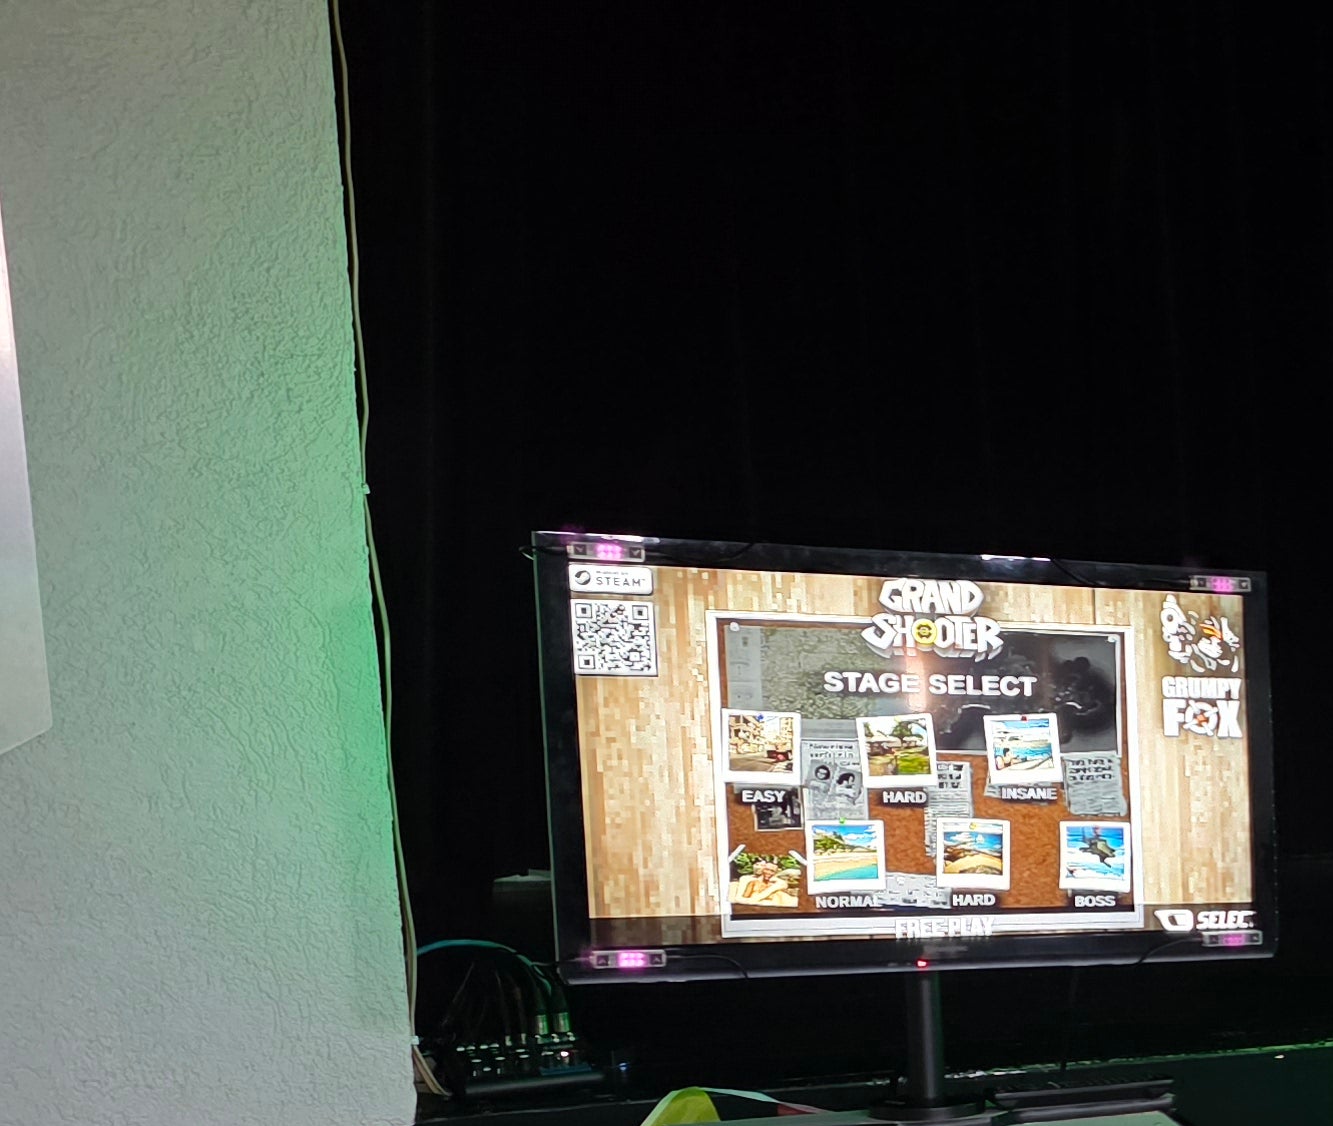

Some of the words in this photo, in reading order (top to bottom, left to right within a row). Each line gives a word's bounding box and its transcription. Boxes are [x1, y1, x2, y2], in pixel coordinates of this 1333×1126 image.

[878, 578, 985, 616] GRAND
[861, 612, 1004, 657] SHOOTER
[823, 671, 920, 695] STAGE
[928, 674, 1038, 698] SELECT
[1161, 676, 1242, 700] GRUMPY
[741, 789, 786, 803] EASY
[882, 790, 927, 804] HARD
[1001, 787, 1058, 801] INSANE
[815, 895, 882, 909] NORMAL
[952, 893, 996, 907] HARD
[1074, 895, 1116, 908] BOSS
[895, 919, 948, 939] FREE
[948, 917, 994, 937] PLAY
